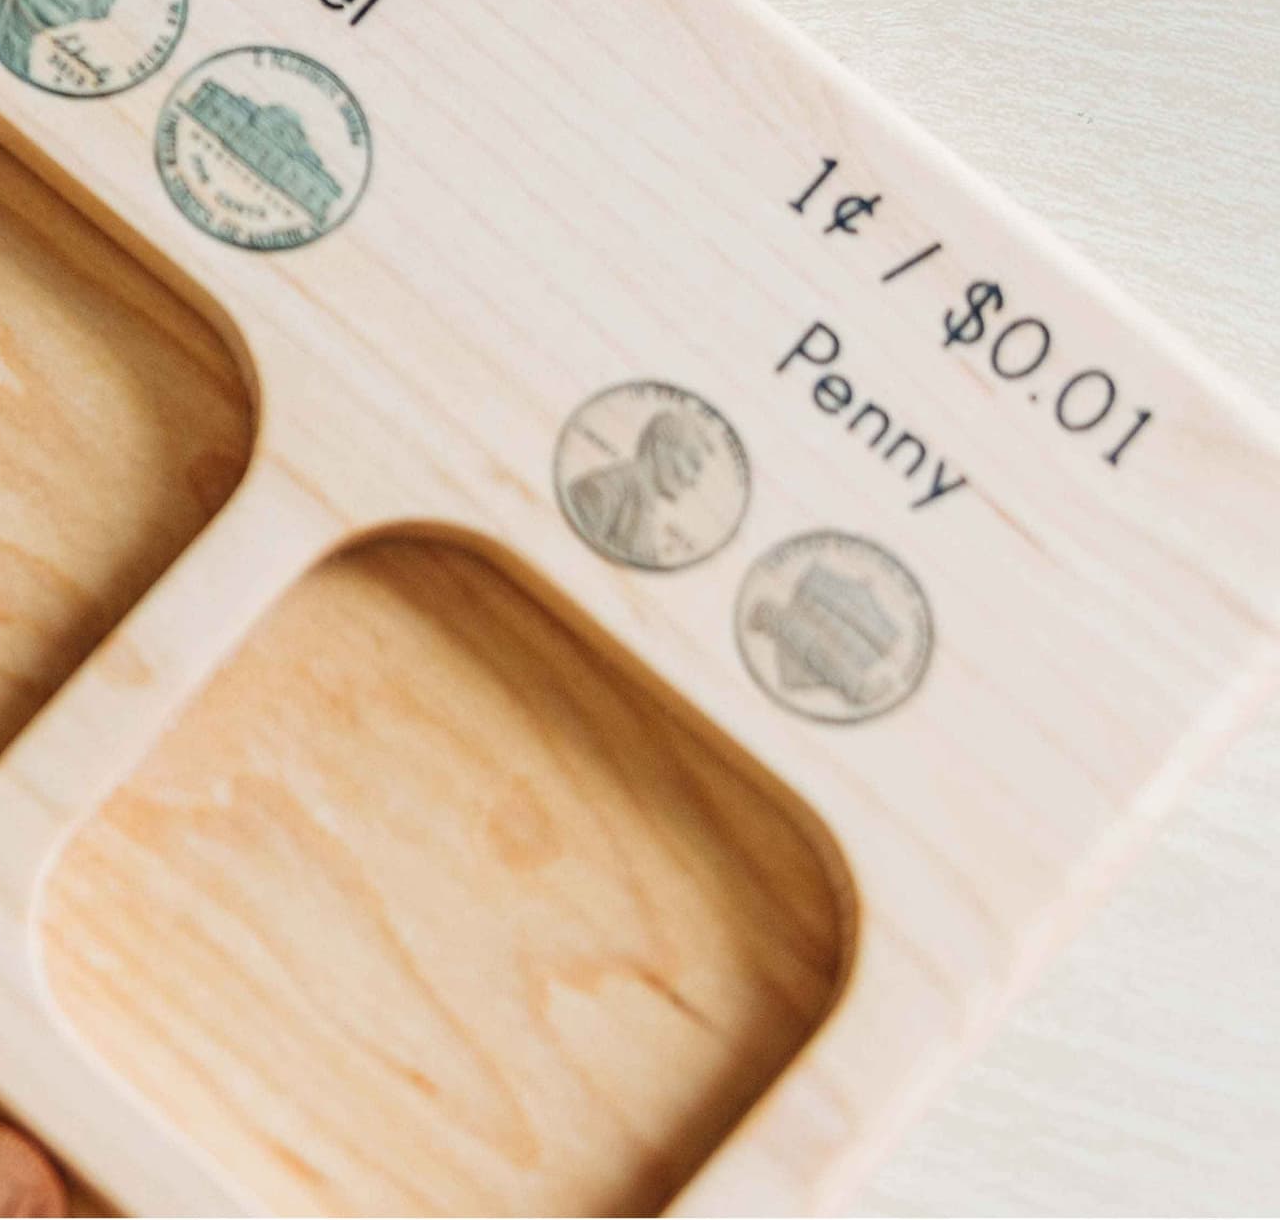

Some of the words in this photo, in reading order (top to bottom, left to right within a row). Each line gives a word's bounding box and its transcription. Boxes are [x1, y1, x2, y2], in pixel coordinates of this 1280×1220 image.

[776, 321, 967, 508] Penny
[789, 158, 882, 235] 1¢
[882, 242, 942, 282] /
[943, 281, 1152, 467] $0.01
